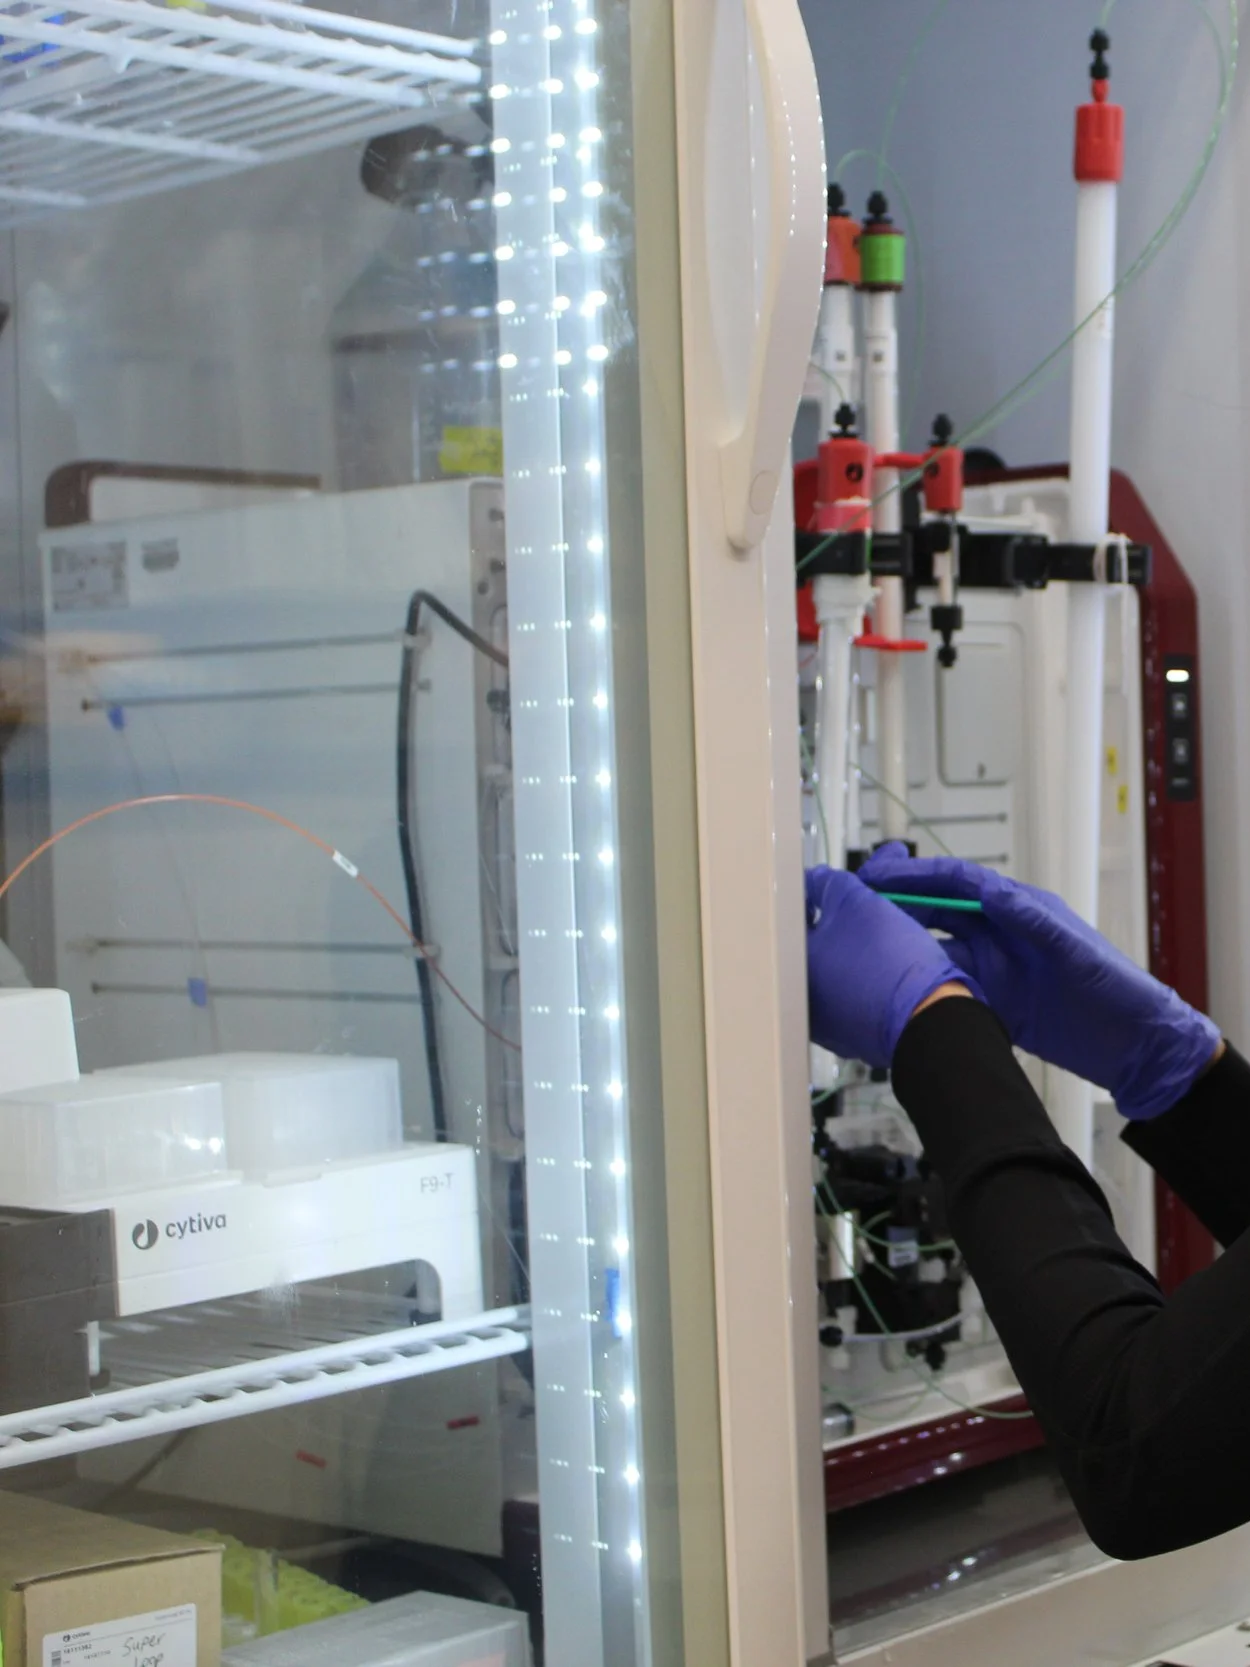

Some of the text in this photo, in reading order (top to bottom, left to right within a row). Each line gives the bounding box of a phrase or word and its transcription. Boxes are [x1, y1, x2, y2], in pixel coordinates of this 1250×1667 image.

[420, 1172, 455, 1193] F9-T
[165, 1212, 227, 1240] cytiva
[122, 1632, 167, 1658] Super
